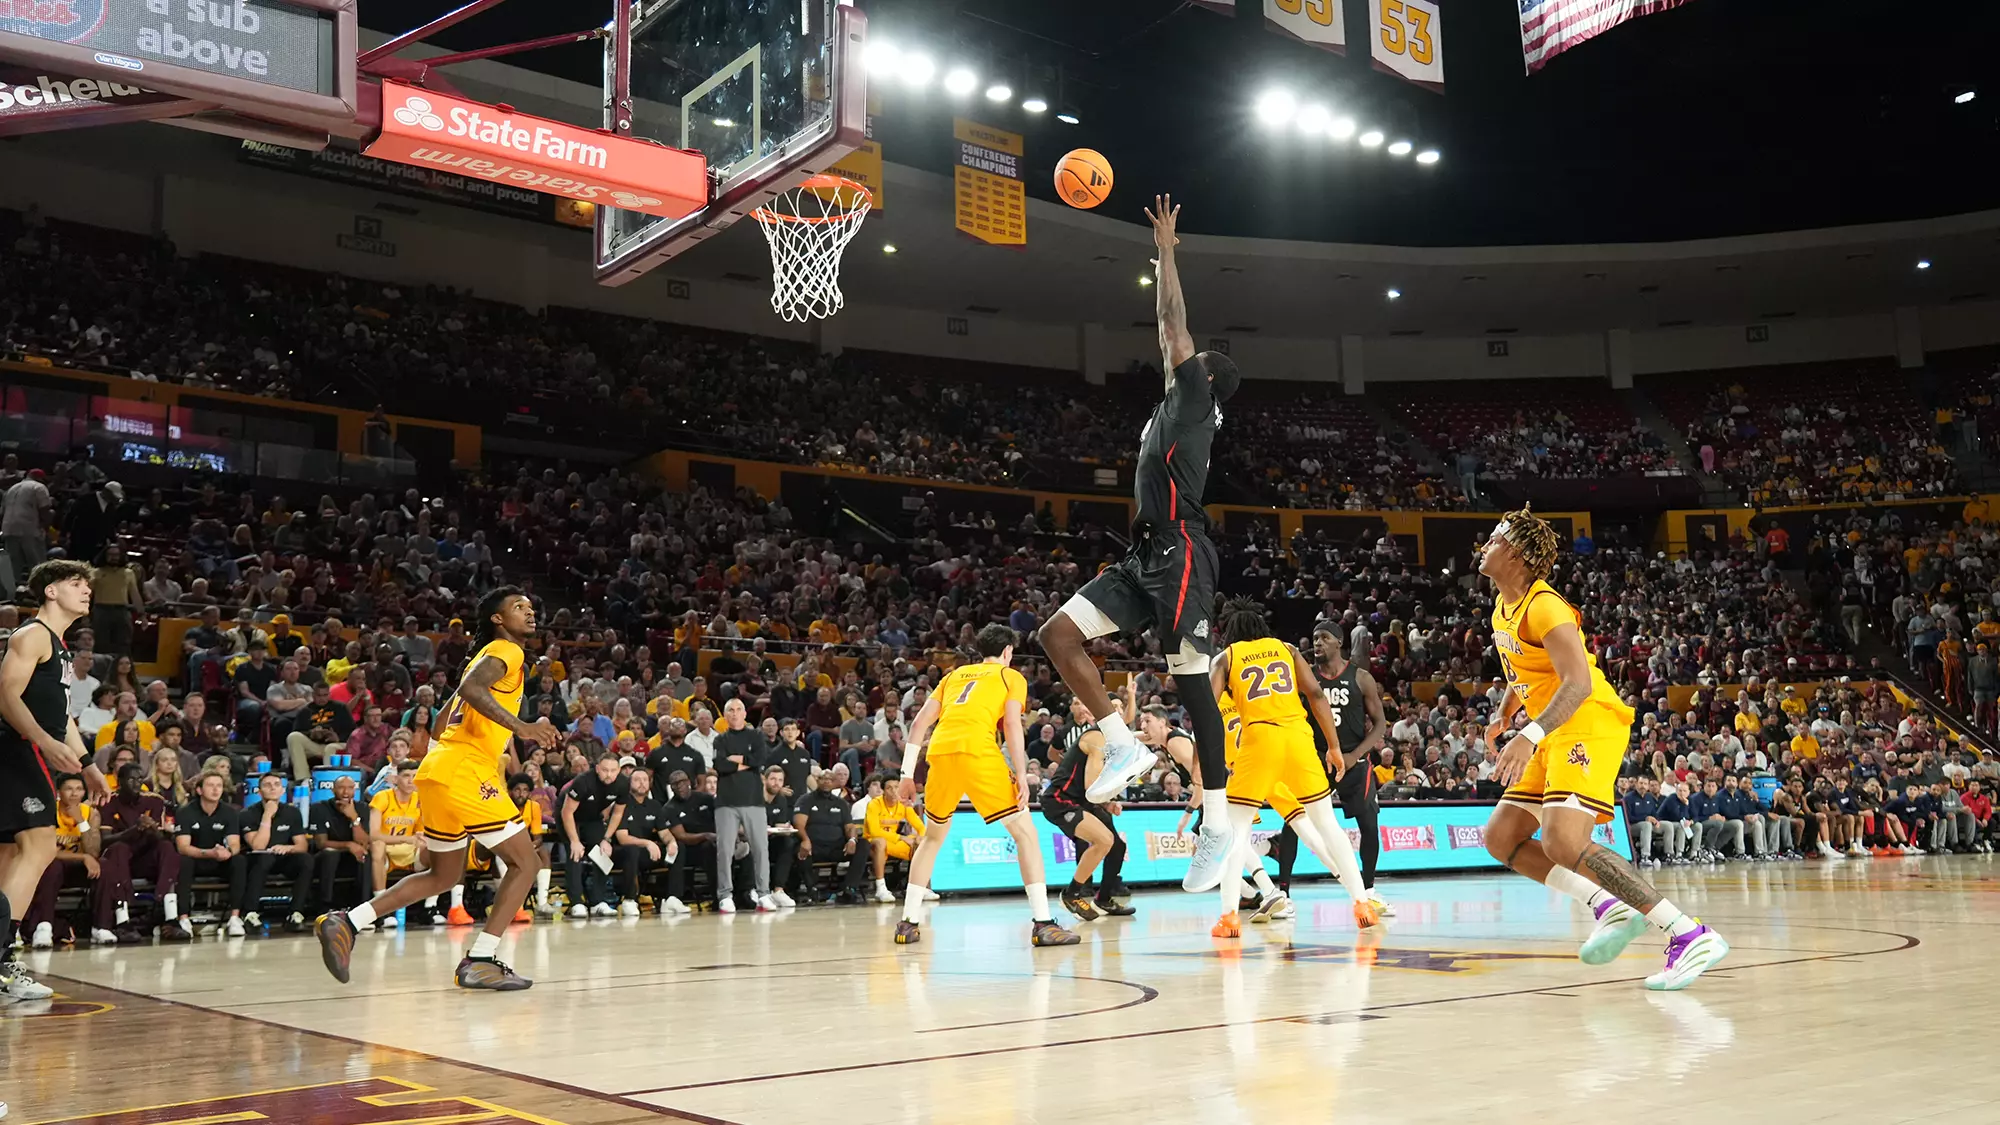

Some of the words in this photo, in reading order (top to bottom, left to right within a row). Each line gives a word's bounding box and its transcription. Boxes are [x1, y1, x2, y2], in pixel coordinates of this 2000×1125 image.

[187, 0, 260, 34] sub
[1380, 0, 1433, 65] 53
[137, 23, 268, 75] above
[101, 56, 113, 64] Van
[113, 57, 141, 69] Wagner
[241, 139, 296, 159] FINANCIAL
[961, 143, 1017, 166] CONFERENCE
[961, 154, 1017, 178] CHAMPIONS
[311, 150, 385, 174] Pitchfork
[386, 165, 430, 185] pride,
[431, 171, 465, 190] loud
[466, 180, 495, 196] and
[496, 186, 540, 206] proud
[1241, 650, 1279, 664] MUKEBA
[955, 680, 976, 704] 1
[1240, 660, 1294, 702] 23
[1160, 835, 1186, 848] G2G
[1392, 828, 1413, 842] G2G
[1458, 827, 1478, 840] G2G
[970, 839, 1000, 855] G2G
